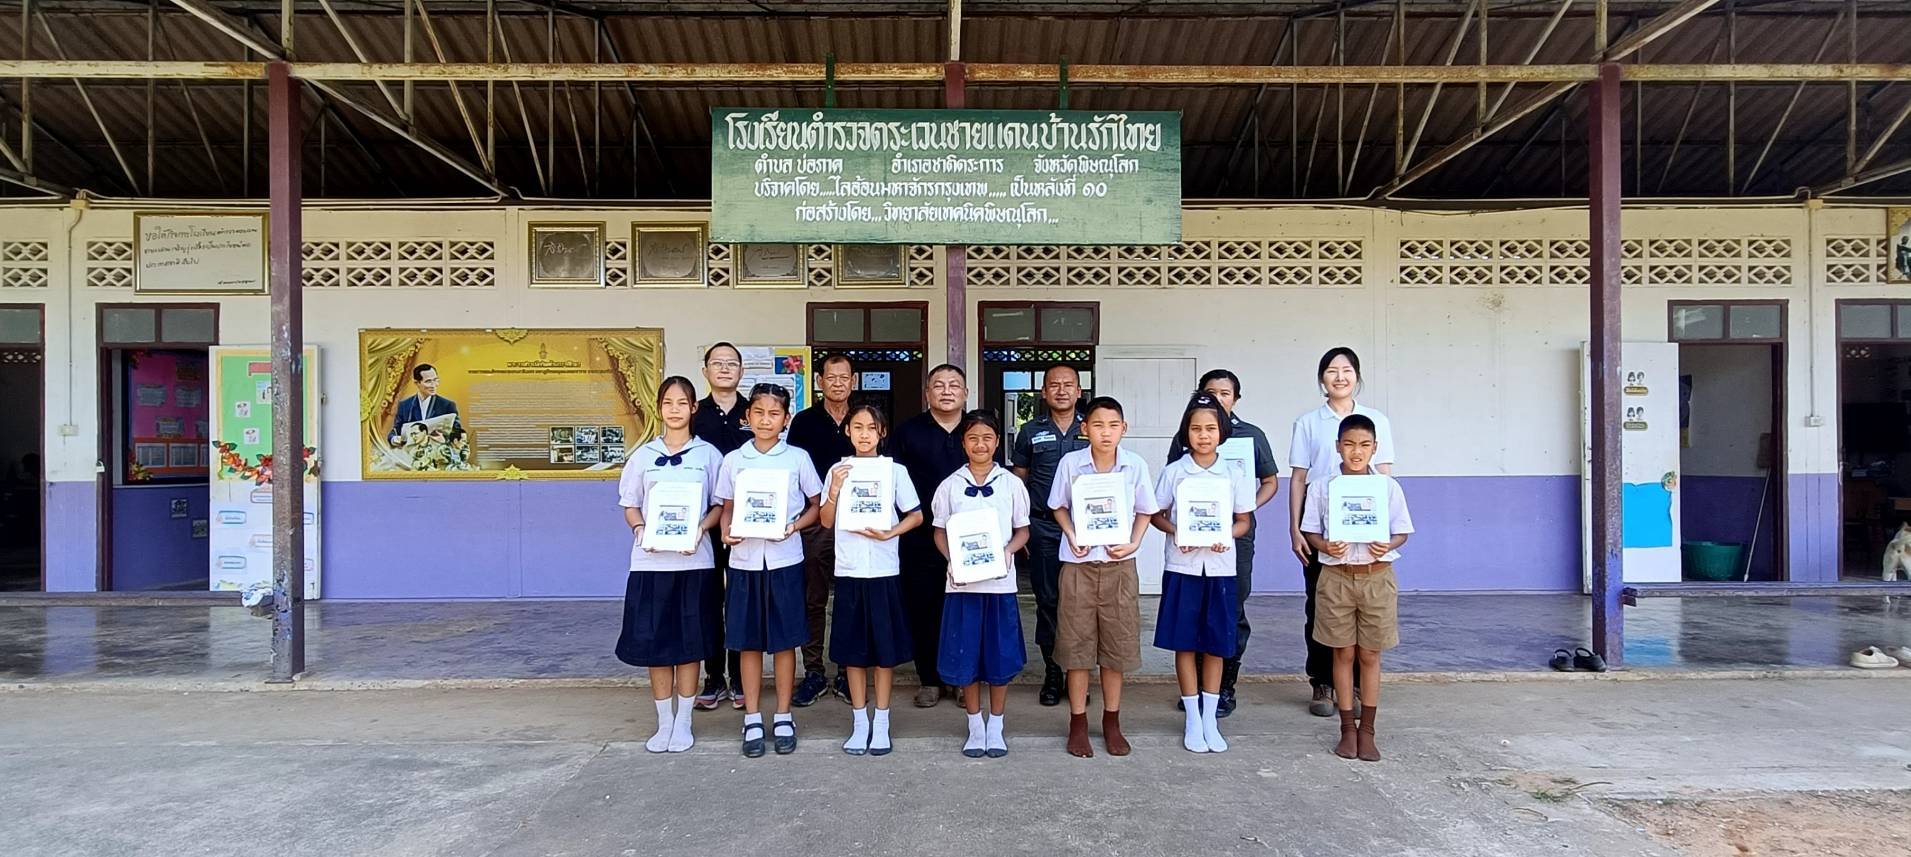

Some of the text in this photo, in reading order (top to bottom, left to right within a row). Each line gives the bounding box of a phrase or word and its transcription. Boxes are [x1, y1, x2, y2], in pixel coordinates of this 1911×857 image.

[754, 152, 1139, 180] ตำบล บ่อภาค อำเภอชาติตระการ จังหวัดพิษณุโลก
[1082, 182, 1108, 198] ๑๐
